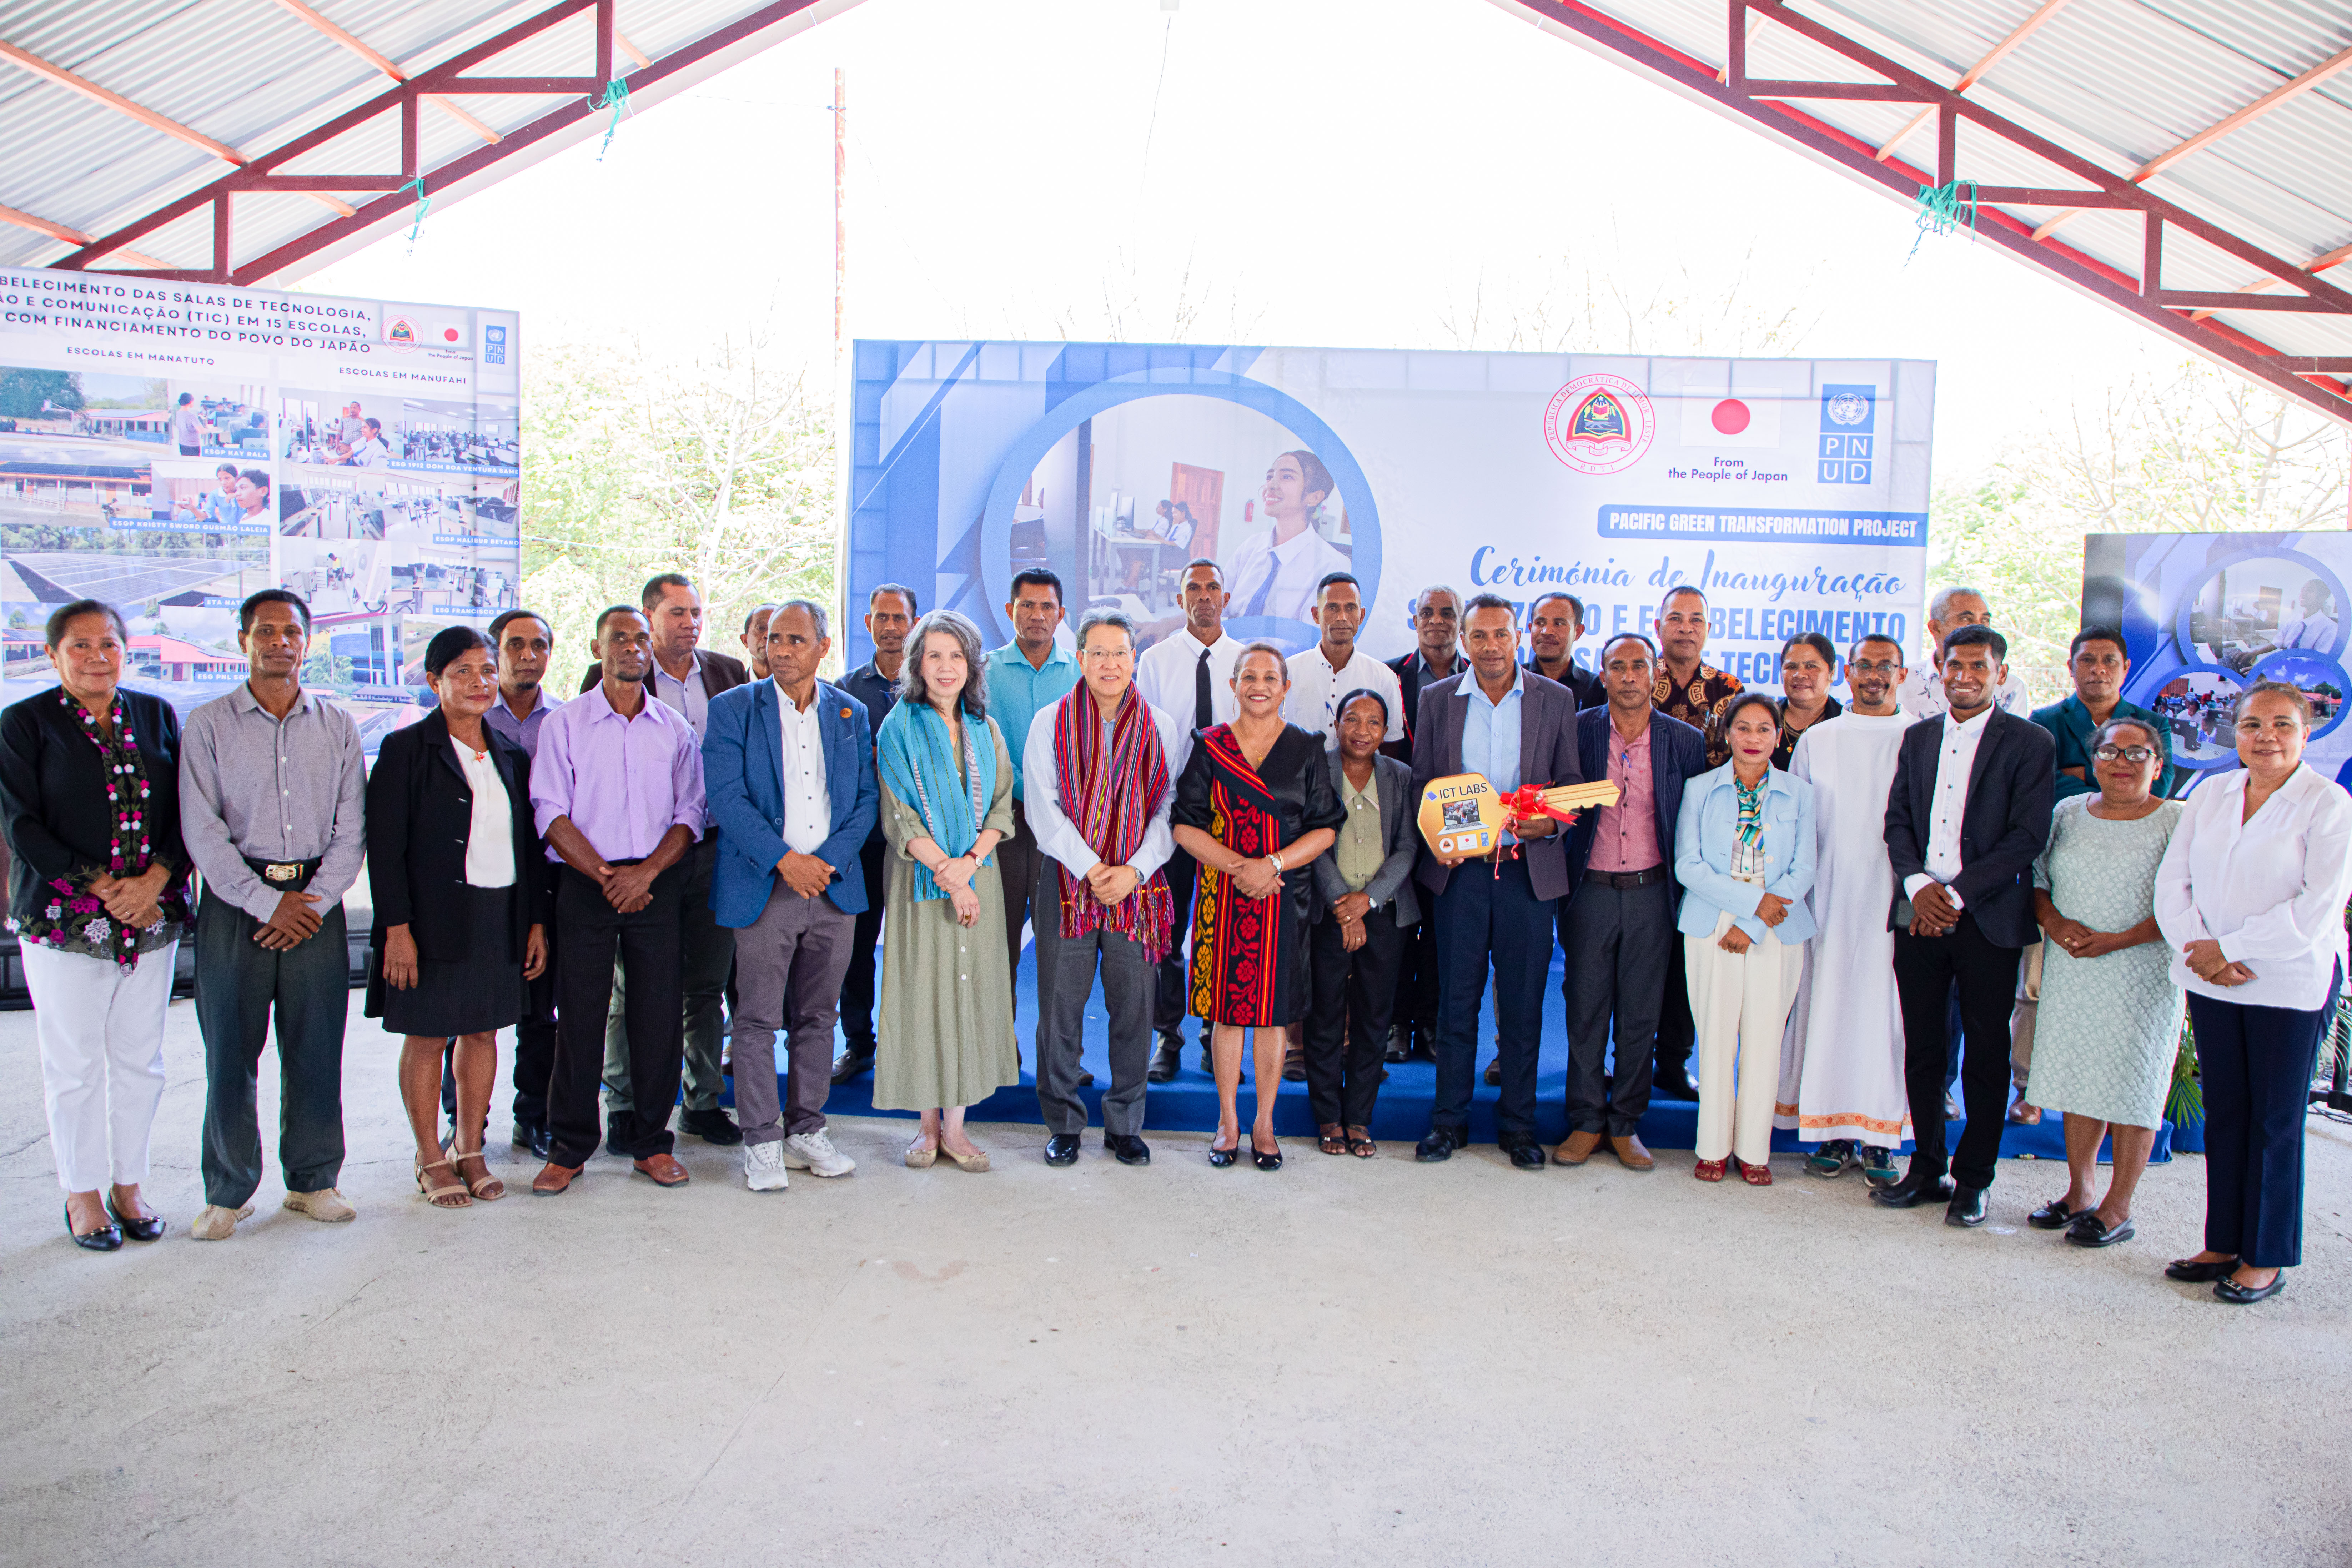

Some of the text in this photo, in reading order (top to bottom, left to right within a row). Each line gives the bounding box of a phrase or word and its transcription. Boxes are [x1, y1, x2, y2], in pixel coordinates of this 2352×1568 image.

[27, 296, 35, 306] E
[42, 297, 180, 320] COMUNICAÇÃO
[187, 310, 230, 325] (TIC)
[238, 316, 259, 326] EM
[266, 318, 281, 328] 15
[288, 320, 366, 338] ESCOLAS,
[133, 289, 166, 301] DAS
[174, 293, 226, 306] SALAS
[233, 298, 252, 309] DE
[260, 301, 371, 321] TECNOLOGIA,
[5, 312, 370, 353] COM FINANCIAMENTO DO POVO DO JAPÃO
[67, 347, 122, 357] ESCOLAS
[149, 354, 215, 365] MANATUTO
[340, 367, 388, 377] ESCOLAS
[412, 374, 466, 384] MANUFAHI
[1546, 398, 1562, 441] REPÚBLICA
[1560, 376, 1618, 397] DEMOCRÁTICA
[1621, 382, 1632, 391] DE
[1668, 468, 1788, 484] the People of Japan
[1714, 456, 1743, 467] From
[1610, 512, 1918, 538] PACIFIC GREEN TRANSFORMATION PROJECT
[1470, 546, 1906, 602] Cerimónia de Inauguração
[1613, 604, 1628, 636] E
[1439, 783, 1487, 799] ICT LABS
